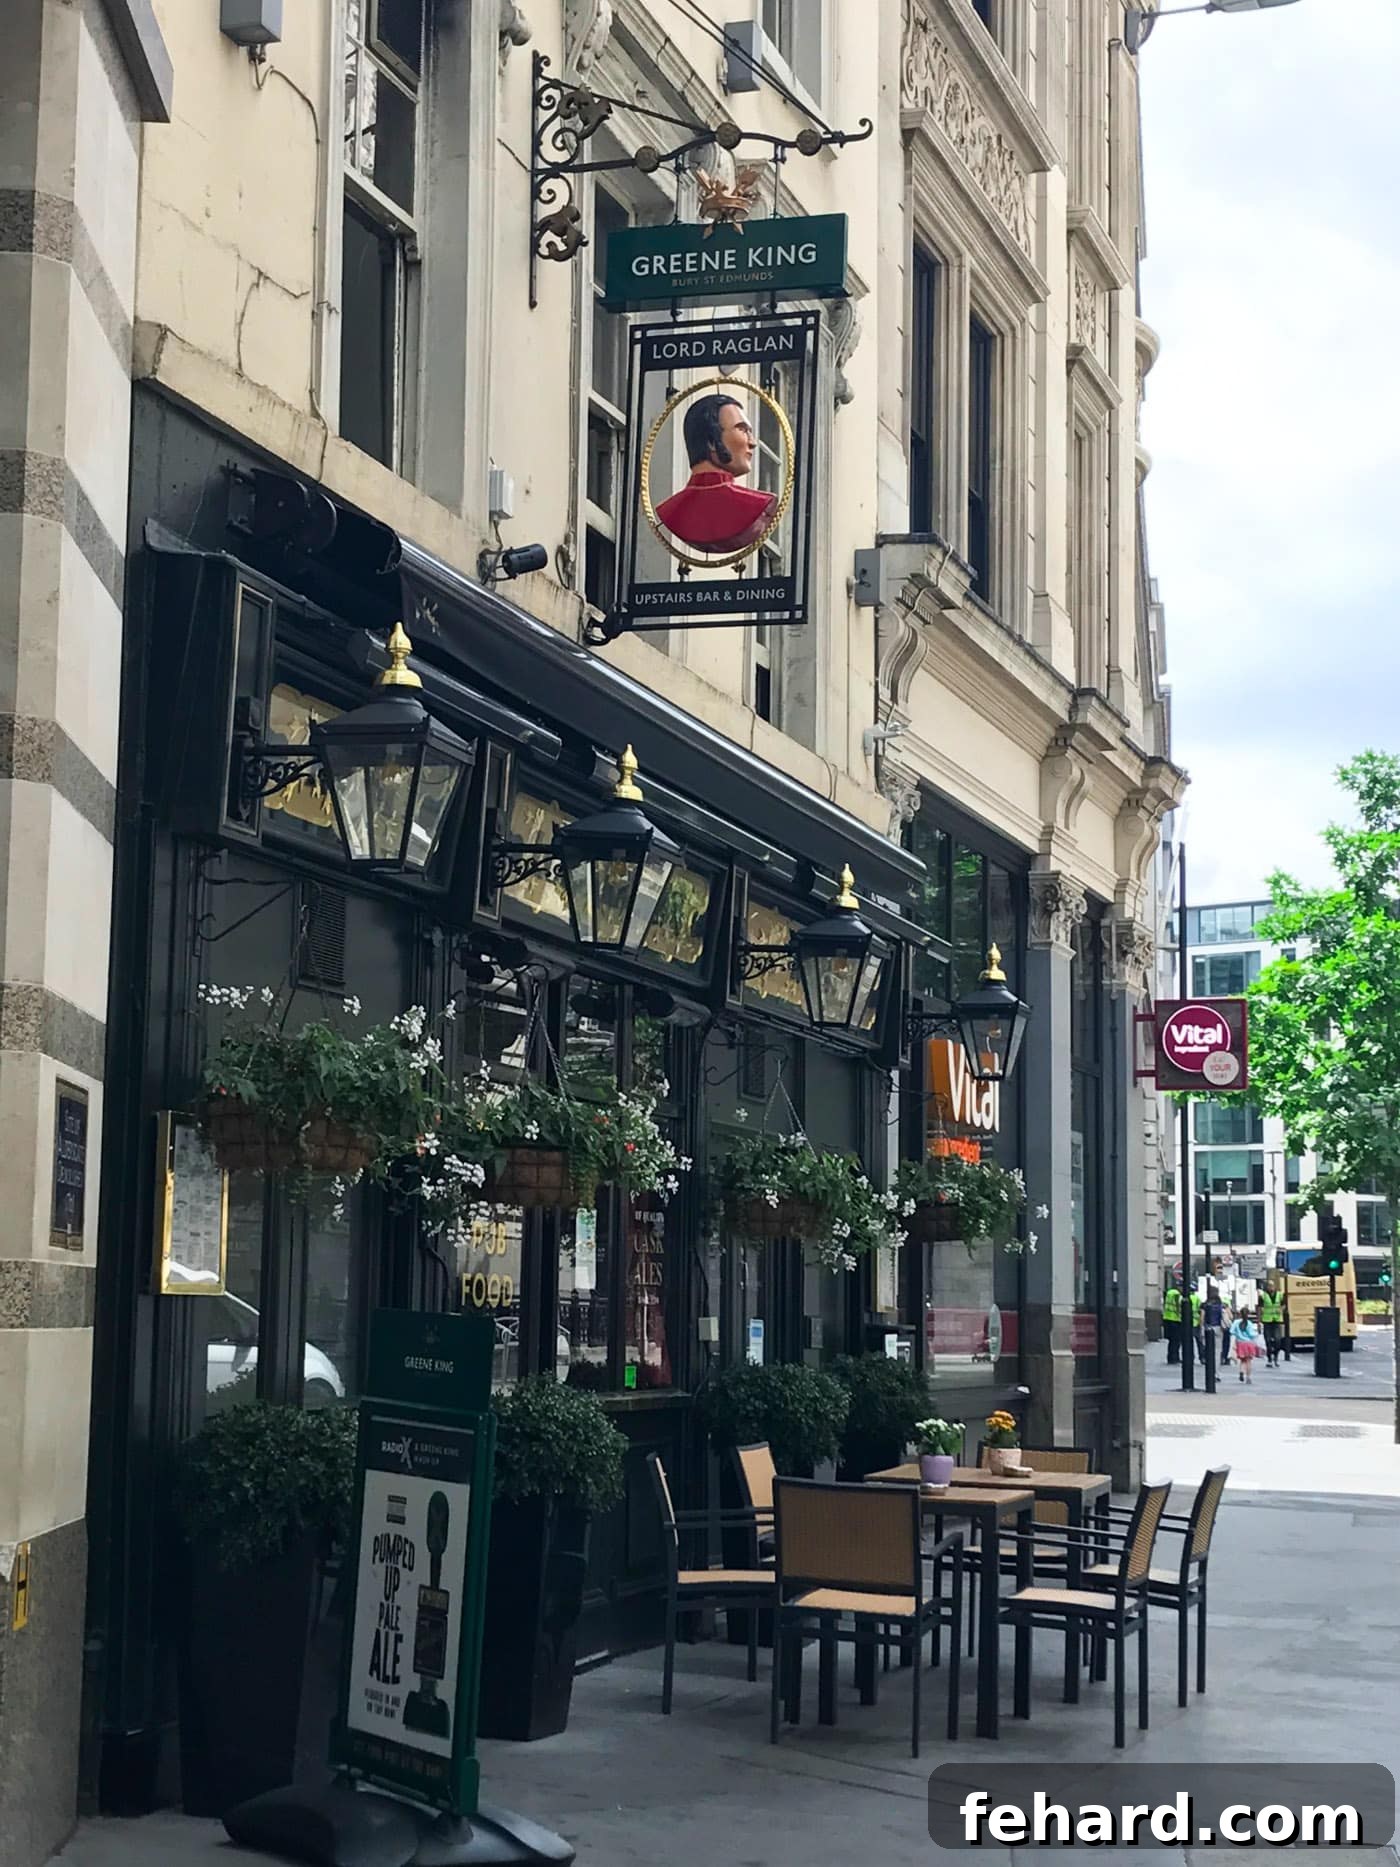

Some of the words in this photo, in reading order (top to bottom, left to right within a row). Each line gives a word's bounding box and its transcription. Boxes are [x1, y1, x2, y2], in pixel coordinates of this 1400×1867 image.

[631, 249, 736, 276] GREENE
[747, 243, 818, 267] KING
[671, 277, 699, 287] BURY
[703, 274, 716, 285] ST
[719, 271, 774, 284] EDMUNDS
[652, 339, 706, 360] LORD
[712, 333, 795, 355] RAGLAN
[635, 591, 693, 605] UPSTAIRS
[696, 590, 721, 602] BAR
[724, 590, 733, 601] &
[736, 587, 785, 600] DINING
[1170, 1023, 1223, 1045] Vital
[634, 1232, 664, 1254] CASK
[634, 1261, 662, 1286] ALES
[461, 1272, 513, 1308] FOOD
[403, 1355, 433, 1371] GREENE
[434, 1359, 454, 1374] KING
[372, 1533, 415, 1572] PUMPED
[384, 1566, 400, 1603] UP
[378, 1601, 401, 1631] PALE
[369, 1627, 403, 1684] ALE
